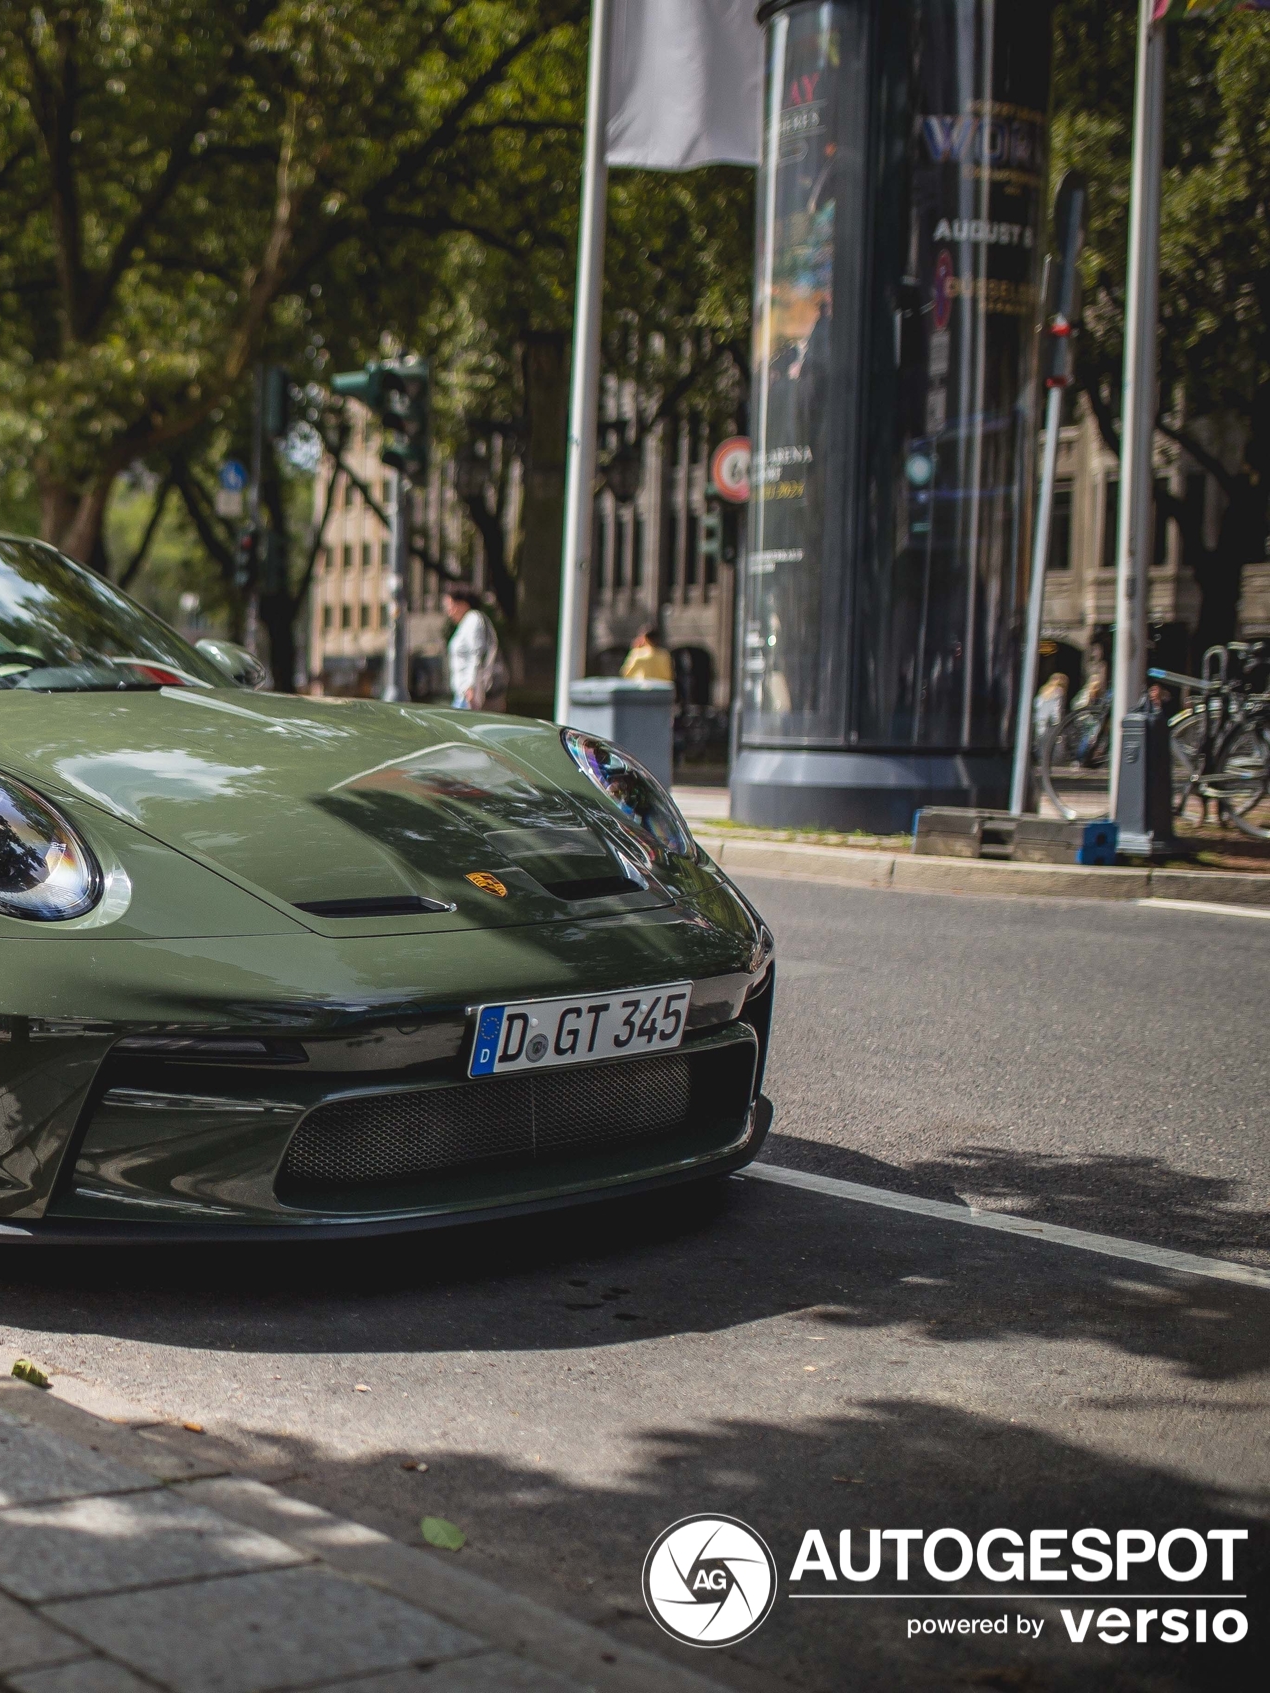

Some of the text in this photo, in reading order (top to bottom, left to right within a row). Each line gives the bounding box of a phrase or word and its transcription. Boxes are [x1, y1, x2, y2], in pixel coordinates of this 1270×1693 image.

[933, 217, 1022, 246] AUGUST
[498, 993, 686, 1063] D GT 345
[480, 1048, 490, 1063] D
